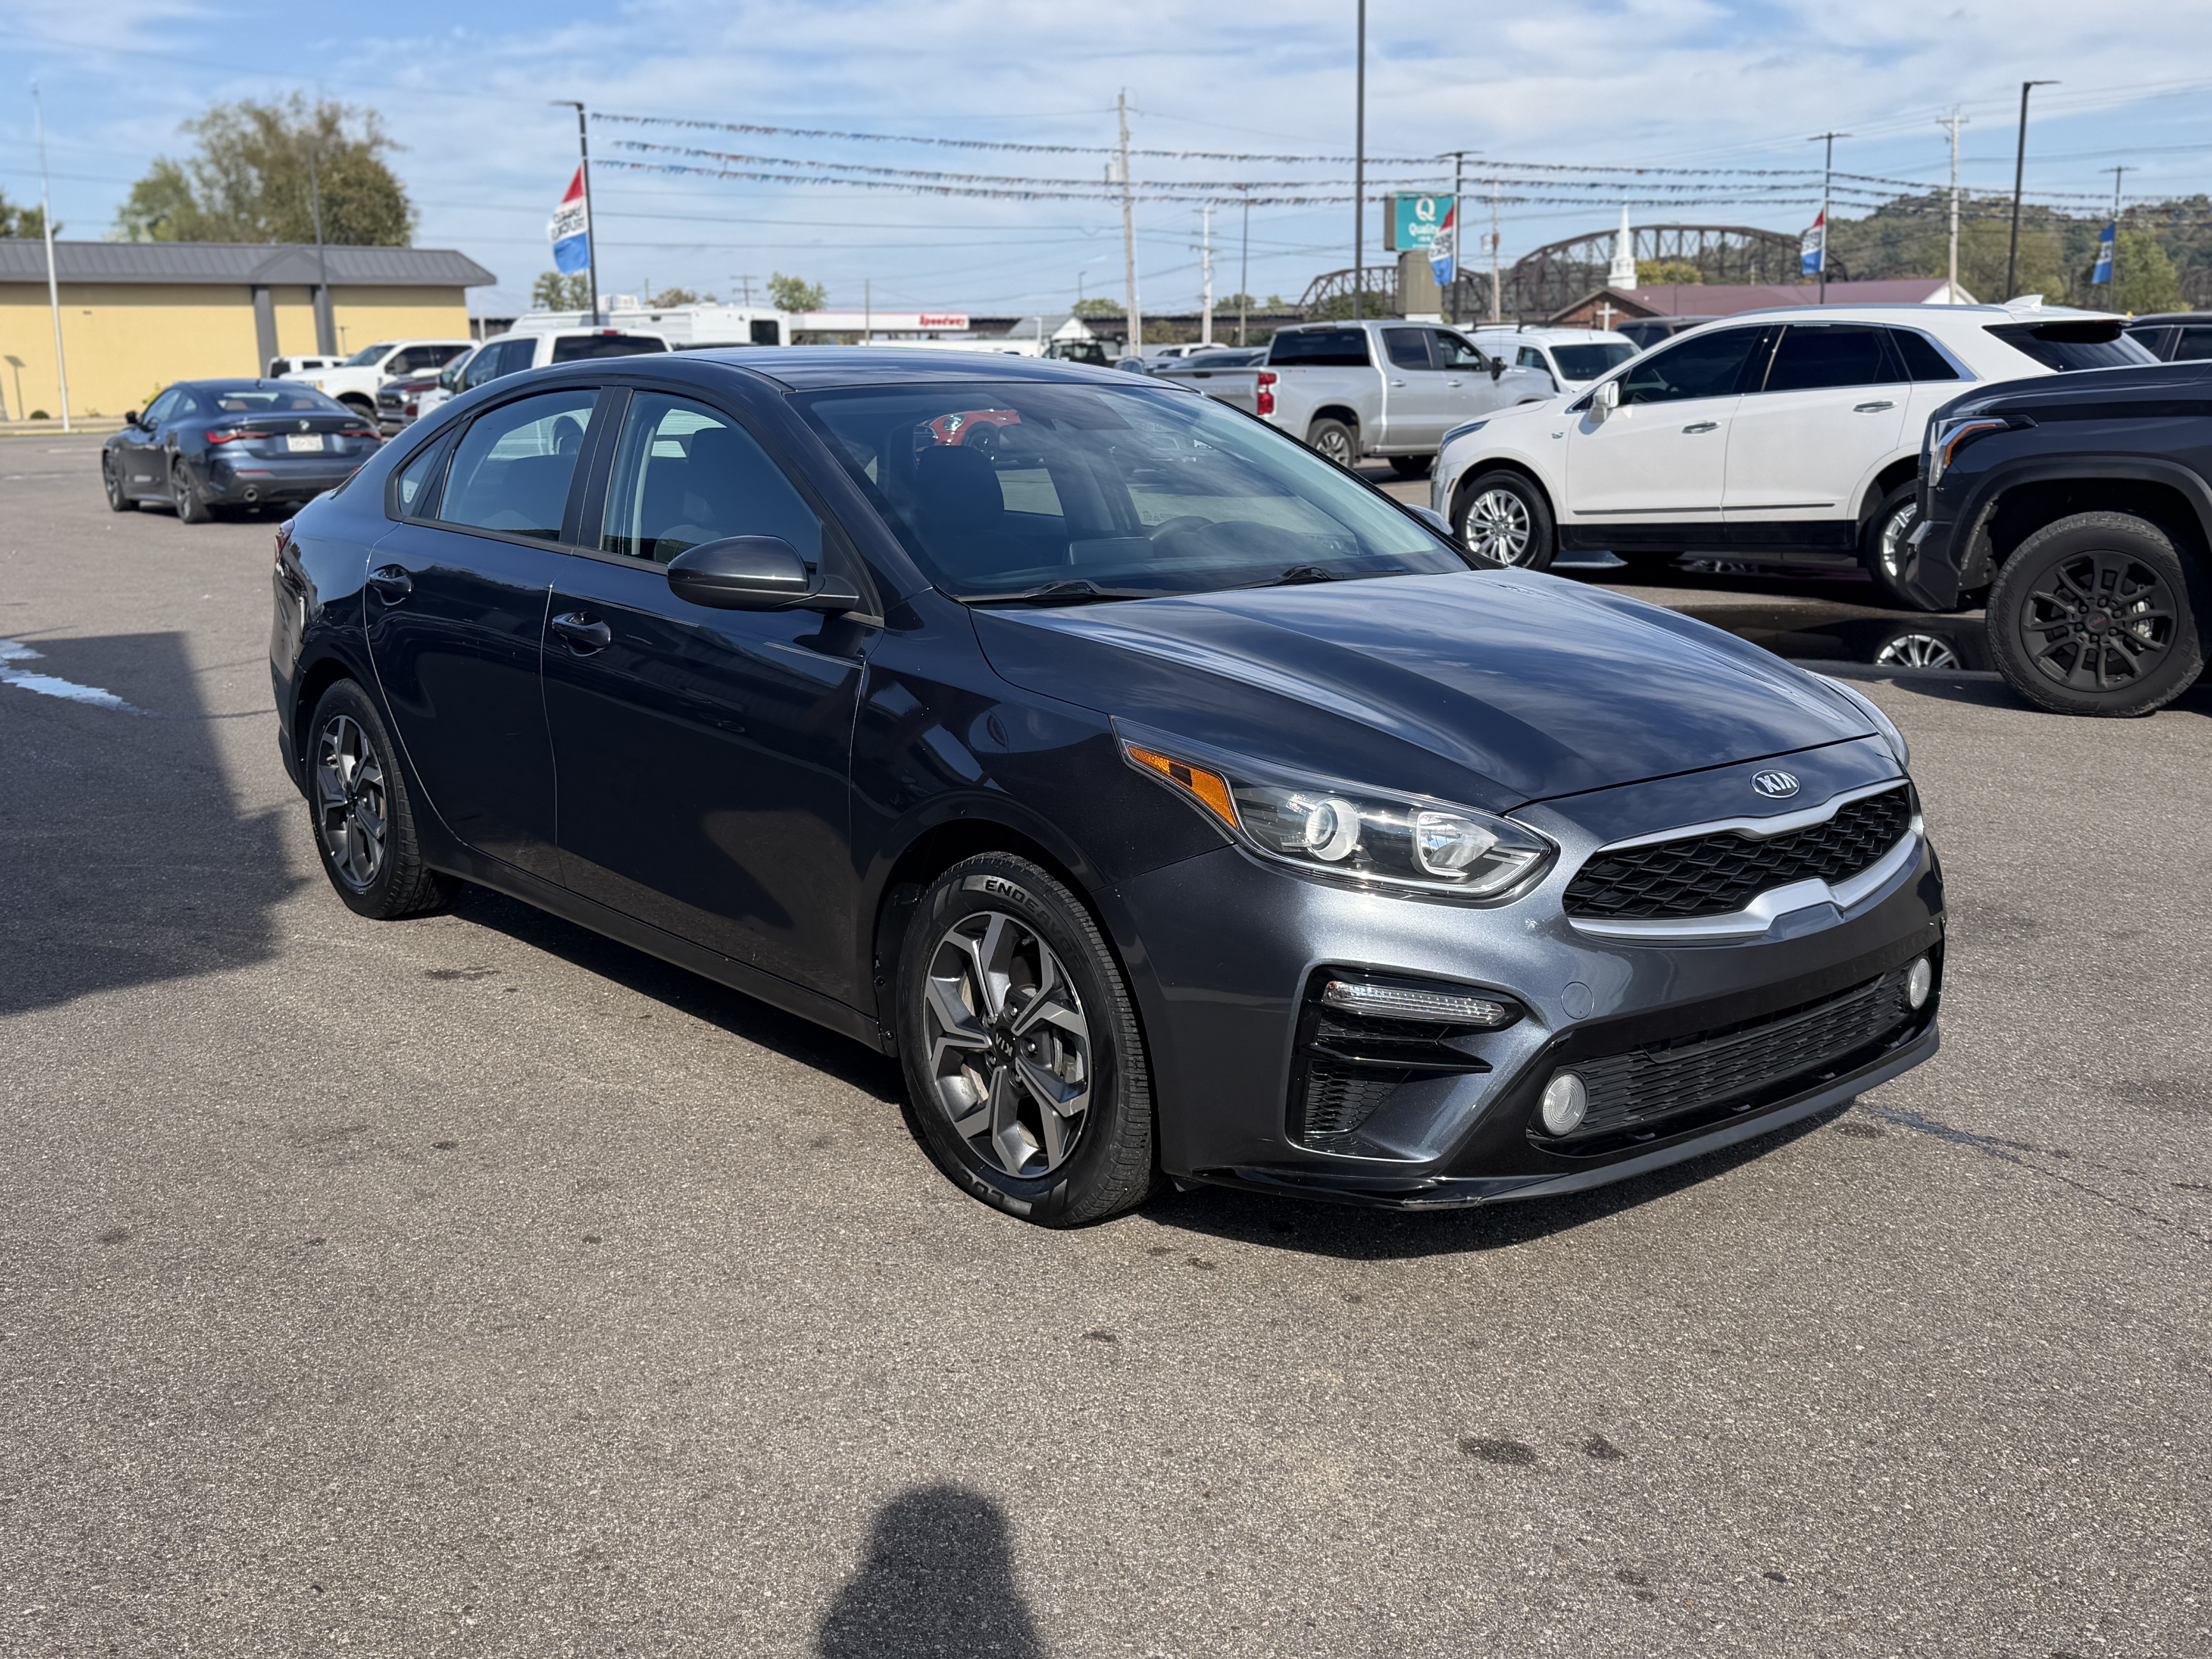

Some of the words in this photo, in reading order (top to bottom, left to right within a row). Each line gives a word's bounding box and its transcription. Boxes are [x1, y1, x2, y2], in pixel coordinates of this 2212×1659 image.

[1415, 197, 1437, 222] Q
[1757, 773, 1797, 793] KIA
[996, 1032, 1013, 1057] KIA
